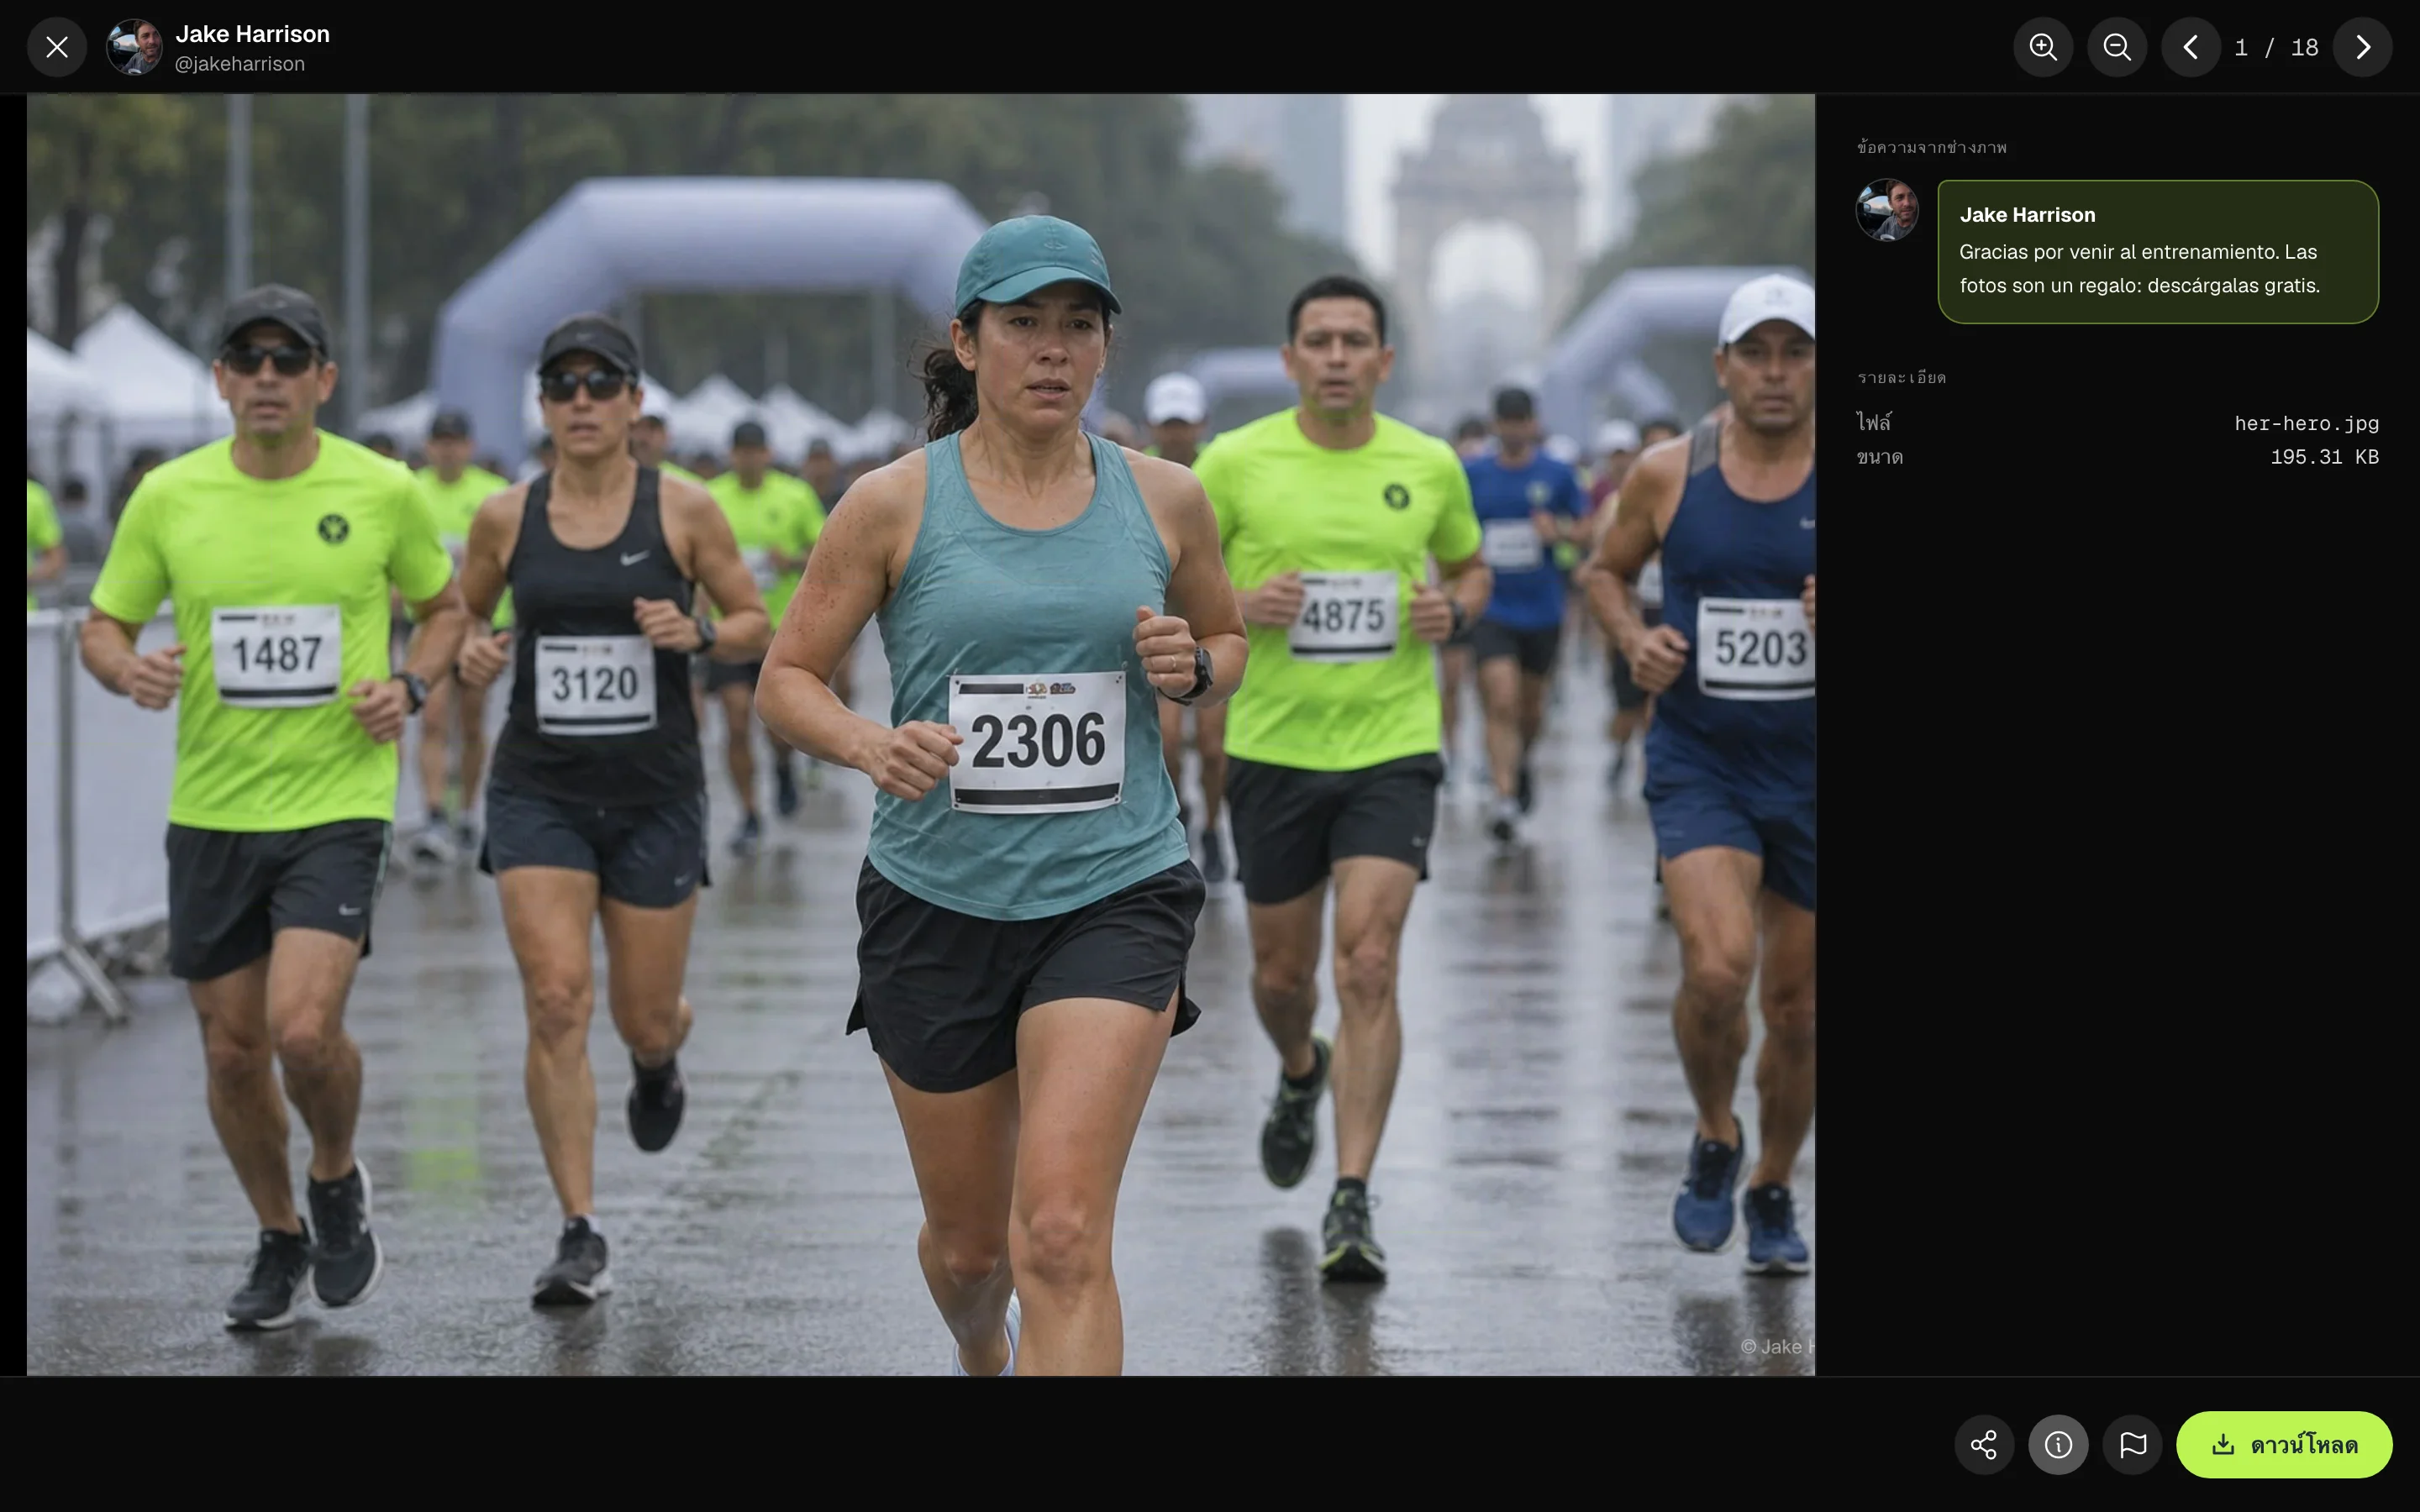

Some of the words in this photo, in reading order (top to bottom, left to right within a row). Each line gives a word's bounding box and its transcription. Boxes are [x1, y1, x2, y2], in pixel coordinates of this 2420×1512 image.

[175, 24, 230, 44] Jake
[236, 24, 330, 44] Harrison
[2235, 38, 2249, 56] 1
[2265, 37, 2275, 59] /
[2291, 37, 2319, 57] 18
[175, 55, 305, 75] @jakeharrison
[1857, 137, 2007, 154] ข้อความจากช่างภาพ
[1960, 207, 2008, 223] Jake
[2012, 206, 2096, 223] Harrison
[1960, 244, 2028, 260] Gracias
[2034, 247, 2065, 264] por
[2069, 244, 2115, 260] venir
[2120, 244, 2137, 260] al
[2141, 244, 2280, 260] entrenamiento.
[2286, 244, 2317, 260] Las
[1960, 277, 2007, 294] fotos
[2012, 281, 2045, 294] son
[2051, 281, 2073, 294] un
[2080, 277, 2142, 297] regalo:
[2148, 276, 2260, 297] descárgalas
[2265, 277, 2320, 297] gratis.
[1858, 368, 1946, 384] รายละเอียด
[1855, 410, 1893, 431] ไฟล์
[2235, 415, 2380, 434] her-hero.jpg
[1856, 451, 1903, 465] ขนาด
[2271, 448, 2344, 465] 195.31
[2355, 449, 2380, 465] KB
[1302, 598, 1385, 633] 4875
[233, 636, 322, 671] 1487
[1717, 628, 1807, 667] 5203
[552, 665, 639, 702] 3120
[971, 711, 1106, 769] 2306
[2251, 1430, 2360, 1455] ดาวน์โหลด
